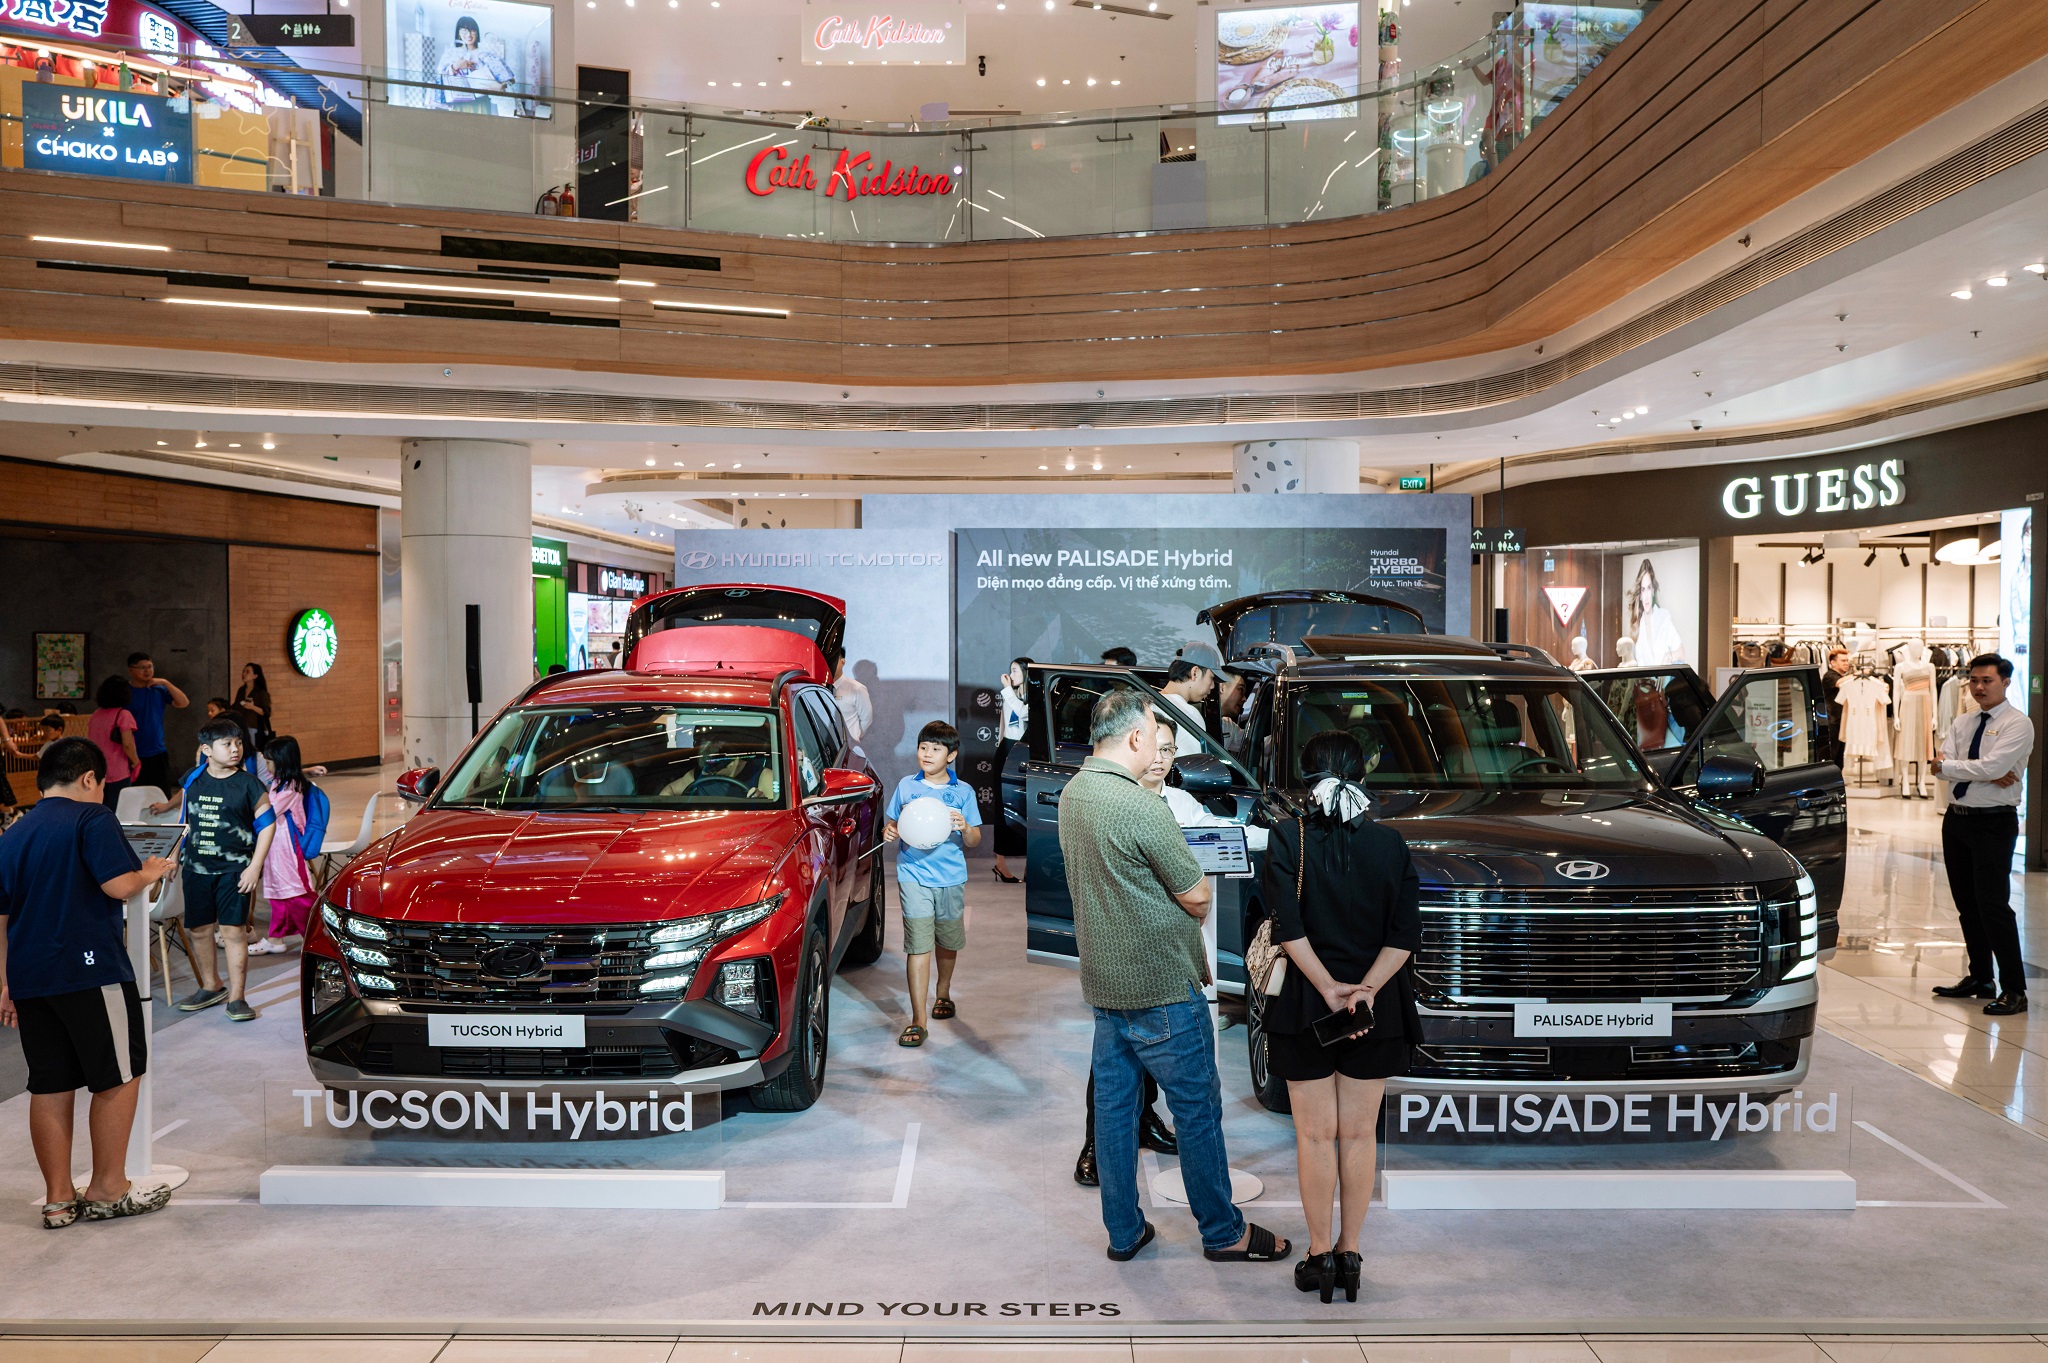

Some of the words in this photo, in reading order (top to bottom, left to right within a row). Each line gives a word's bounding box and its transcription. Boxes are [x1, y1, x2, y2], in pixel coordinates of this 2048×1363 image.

[231, 23, 241, 40] 2
[814, 15, 863, 50] Cath
[862, 15, 946, 50] Kidston
[61, 94, 153, 128] UKILA
[745, 145, 818, 196] Cath
[825, 149, 952, 201] Kidston
[1402, 479, 1418, 489] EXIT
[1722, 458, 1906, 519] GUESS
[1370, 549, 1399, 557] Hyundai
[1471, 542, 1486, 550] ATM
[721, 553, 812, 567] HYUNDAI
[825, 554, 855, 567] TC
[857, 554, 944, 567] MOTOR
[977, 550, 1003, 567] All
[1008, 553, 1052, 567] new
[1057, 550, 1159, 567] PALISADE
[1164, 549, 1233, 570] Hybrid
[1370, 565, 1424, 574] HYBRID
[608, 571, 622, 589] Glam
[977, 575, 1009, 591] Diện
[1012, 578, 1044, 591] mạo
[1047, 573, 1083, 591] đẳng
[1086, 574, 1116, 591] cấp.
[1119, 576, 1133, 591] Vị
[1136, 574, 1159, 589] thế
[1161, 574, 1196, 591] xứng
[1199, 573, 1232, 589] tầm.
[1370, 580, 1381, 588] Uy
[1381, 580, 1395, 588] lực.
[1413, 579, 1424, 587] tế.
[1533, 1013, 1604, 1026] PALISADE
[1606, 1012, 1654, 1029] Hybrid
[451, 1025, 512, 1037] TUCSON
[515, 1024, 563, 1040] Hybrid
[292, 1089, 510, 1130] TUCSON
[527, 1090, 693, 1140] Hybrid
[1400, 1093, 1652, 1134] PALISADE
[1668, 1092, 1838, 1141] Hybrid
[752, 1302, 866, 1317] MIND
[876, 1302, 989, 1317] YOUR
[998, 1302, 1122, 1317] STEPS
